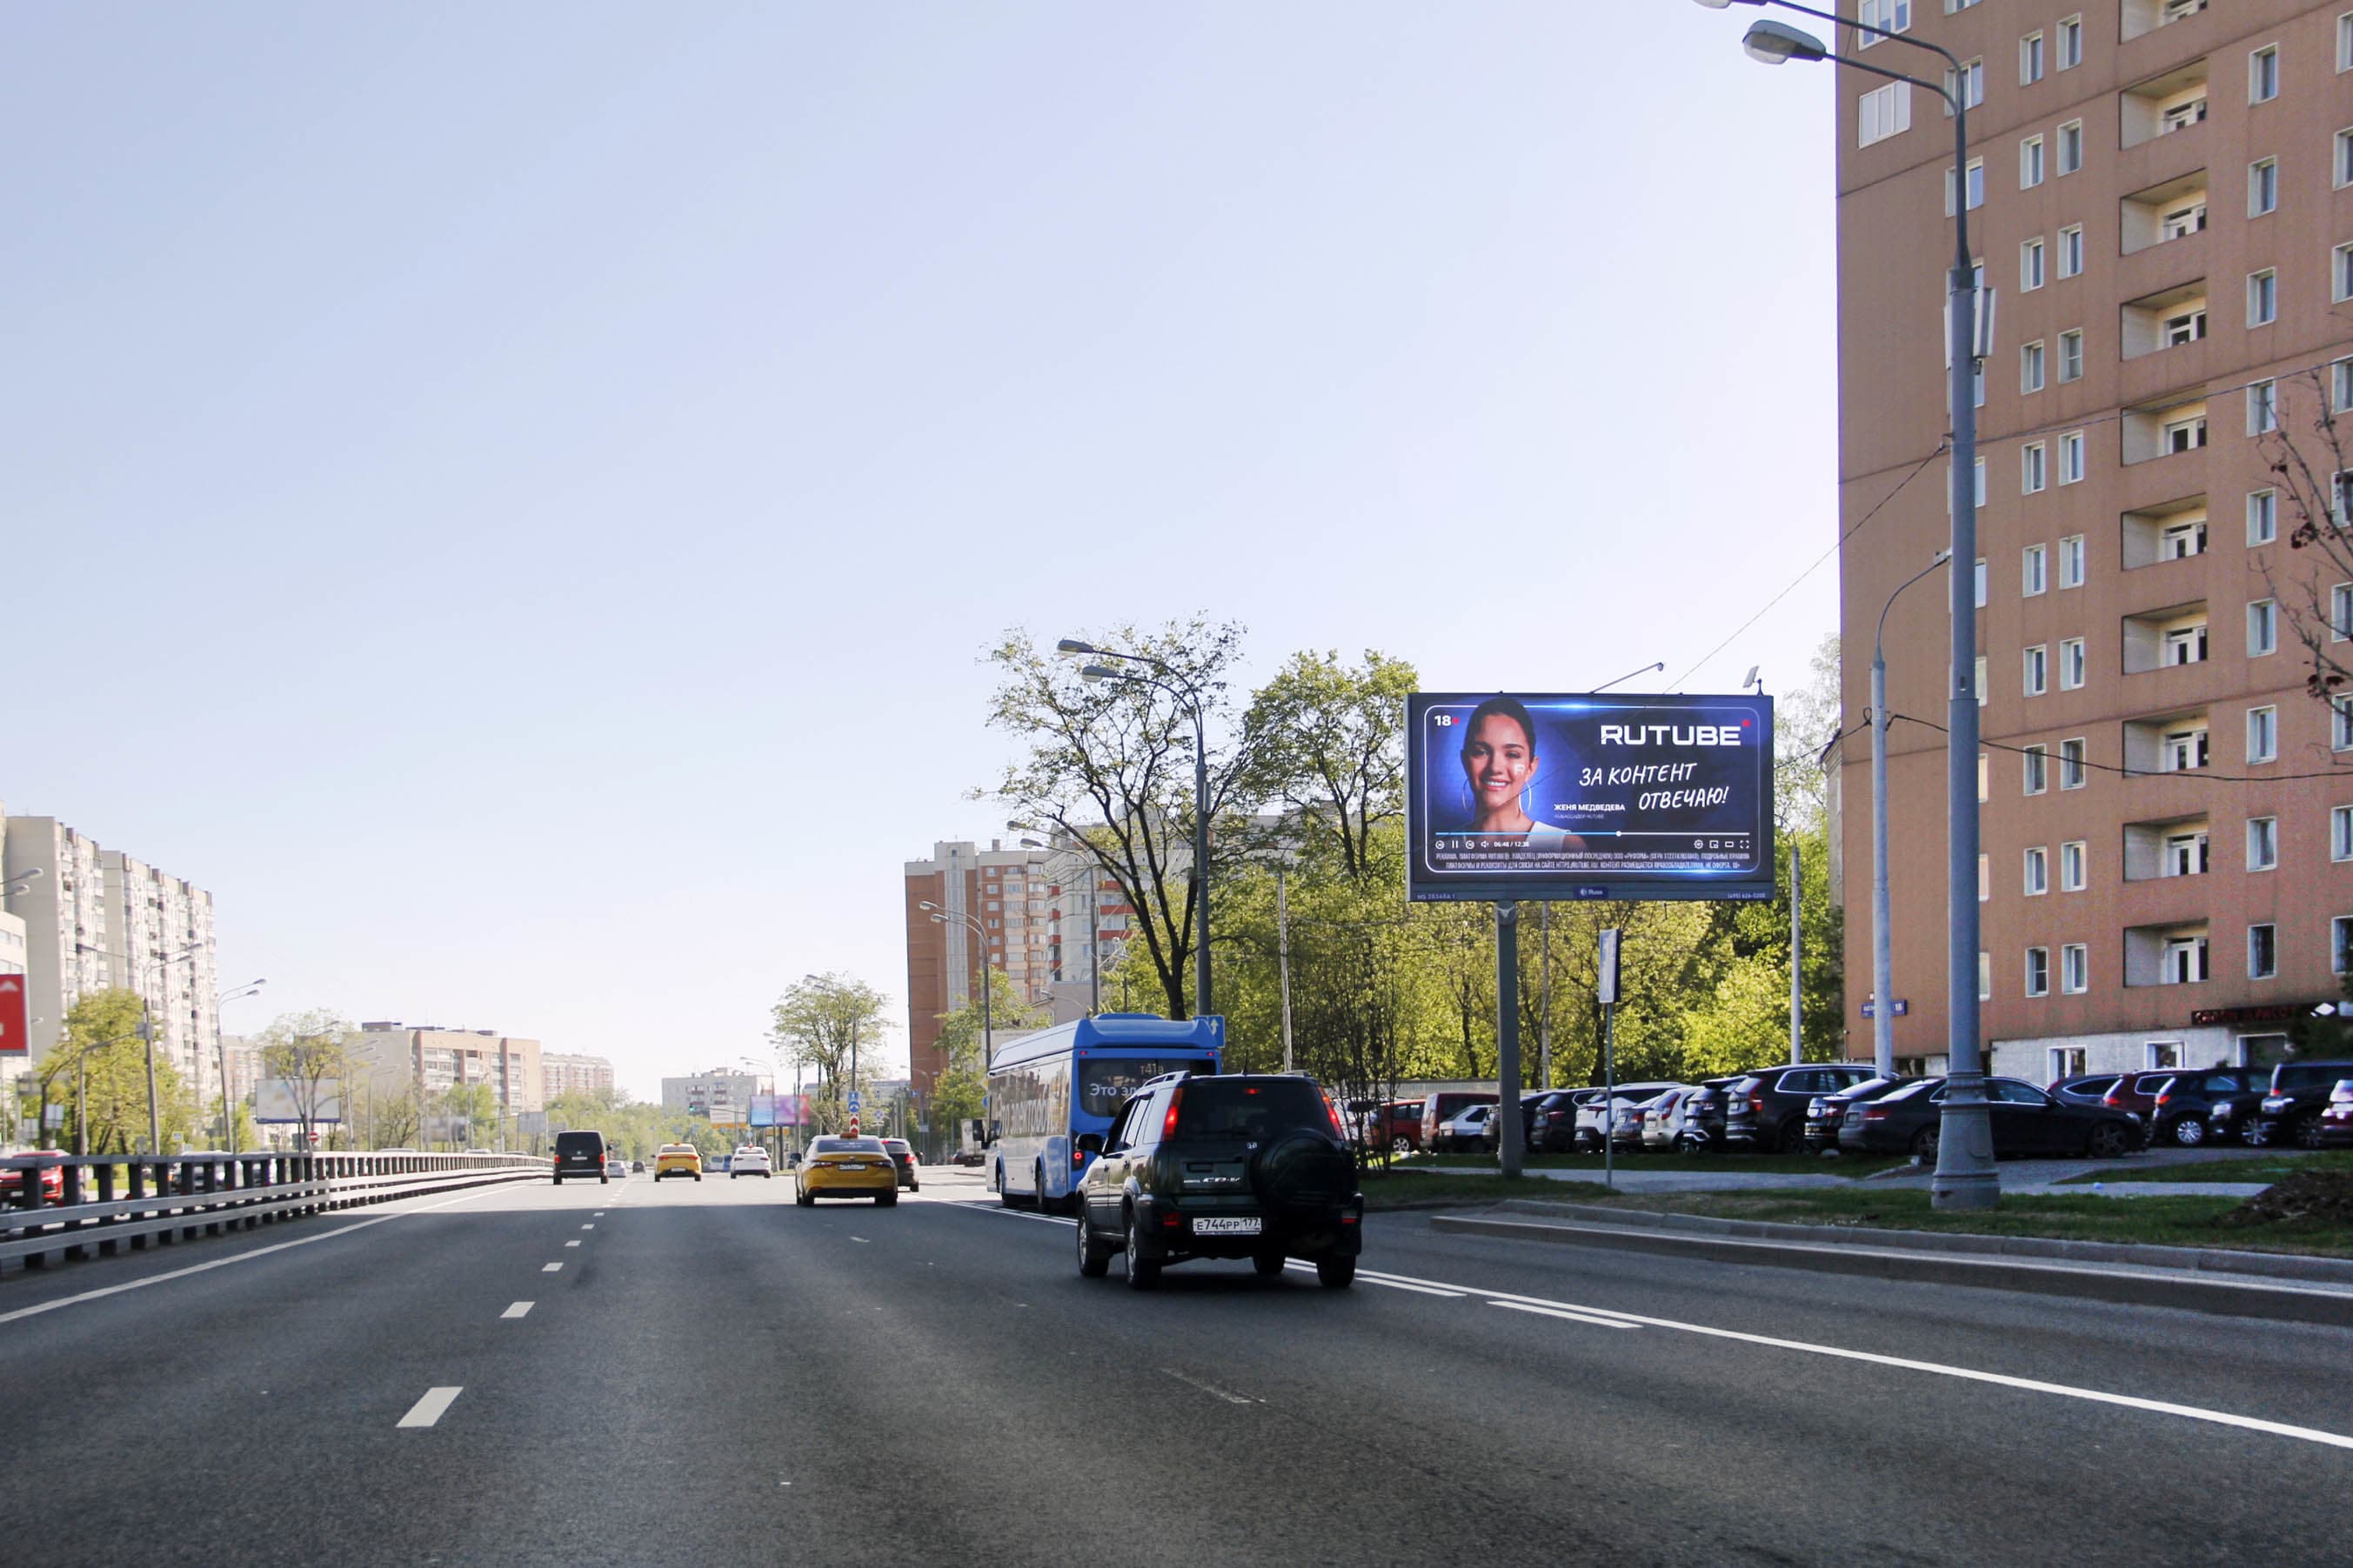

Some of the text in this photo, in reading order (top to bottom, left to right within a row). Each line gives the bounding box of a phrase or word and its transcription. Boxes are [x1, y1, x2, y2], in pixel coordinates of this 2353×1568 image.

[1601, 725, 1741, 745] RUTUBE
[1579, 763, 1698, 786] ЗА КОНТЕНТ
[1639, 786, 1729, 810] ОТВЕЧАЮ!
[1089, 1083, 1116, 1096] Это
[1242, 1218, 1259, 1226] 177
